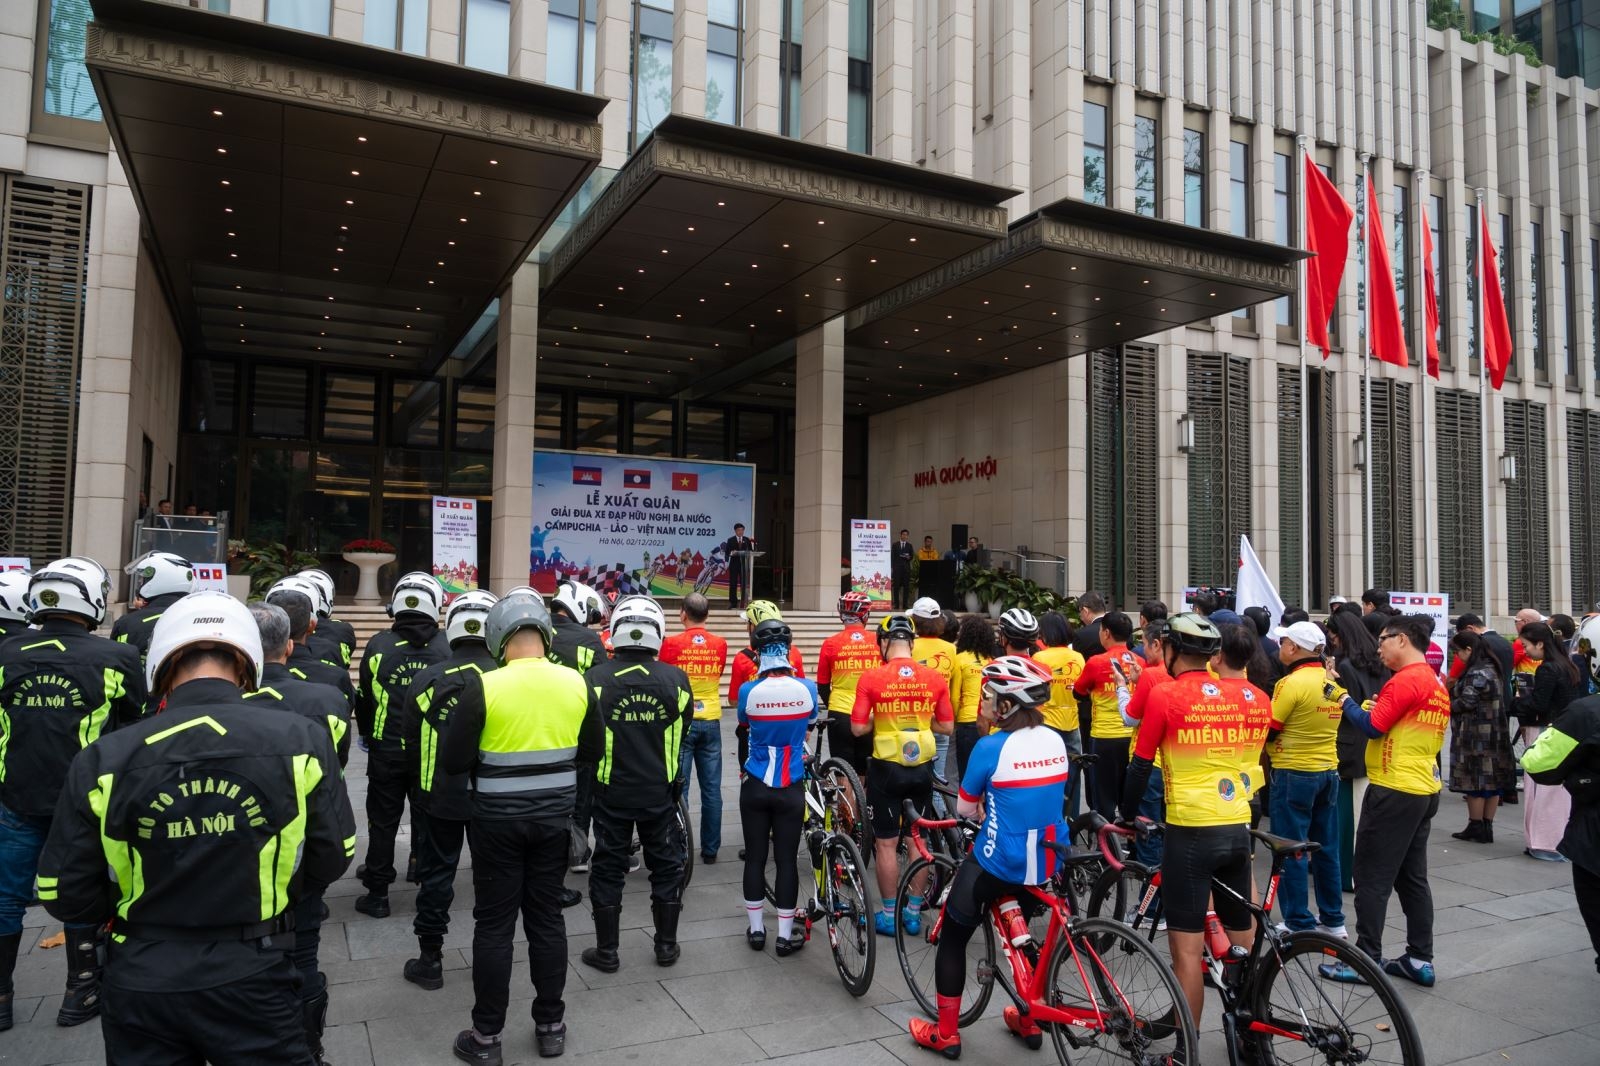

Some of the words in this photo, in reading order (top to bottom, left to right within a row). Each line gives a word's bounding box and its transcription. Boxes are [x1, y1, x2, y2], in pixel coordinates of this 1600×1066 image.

[915, 466, 937, 488] NHÀ
[940, 457, 973, 484] QUỐC
[976, 455, 996, 481] HỘI
[586, 490, 600, 505] LỄ
[604, 492, 638, 507] XUẤT
[642, 496, 680, 509] QUÂN
[551, 506, 571, 518] GIẢI
[574, 508, 592, 518] ĐUA
[594, 510, 606, 518] XE
[608, 511, 626, 521] ĐẠP
[629, 510, 646, 520] HỮU
[649, 513, 670, 524] NGHỊ
[673, 514, 684, 522] BA
[687, 513, 712, 524] NƯỚC
[545, 522, 601, 532] CAMPUCHIA
[638, 524, 654, 536] VIỆT
[656, 526, 676, 535] NAM
[678, 527, 694, 536] CLV
[696, 528, 716, 536] 2023
[408, 662, 428, 670] THÀN
[26, 694, 43, 706] HÀ
[45, 694, 65, 708] NỘI
[625, 710, 638, 721] HÀ
[640, 710, 655, 723] NỘI
[1222, 714, 1234, 722] TAY
[1177, 724, 1224, 744] MIỀN
[1014, 756, 1065, 770] MIMECO
[178, 776, 241, 799] THÀNH
[166, 816, 197, 838] HÀ
[201, 812, 236, 836] NỘI
